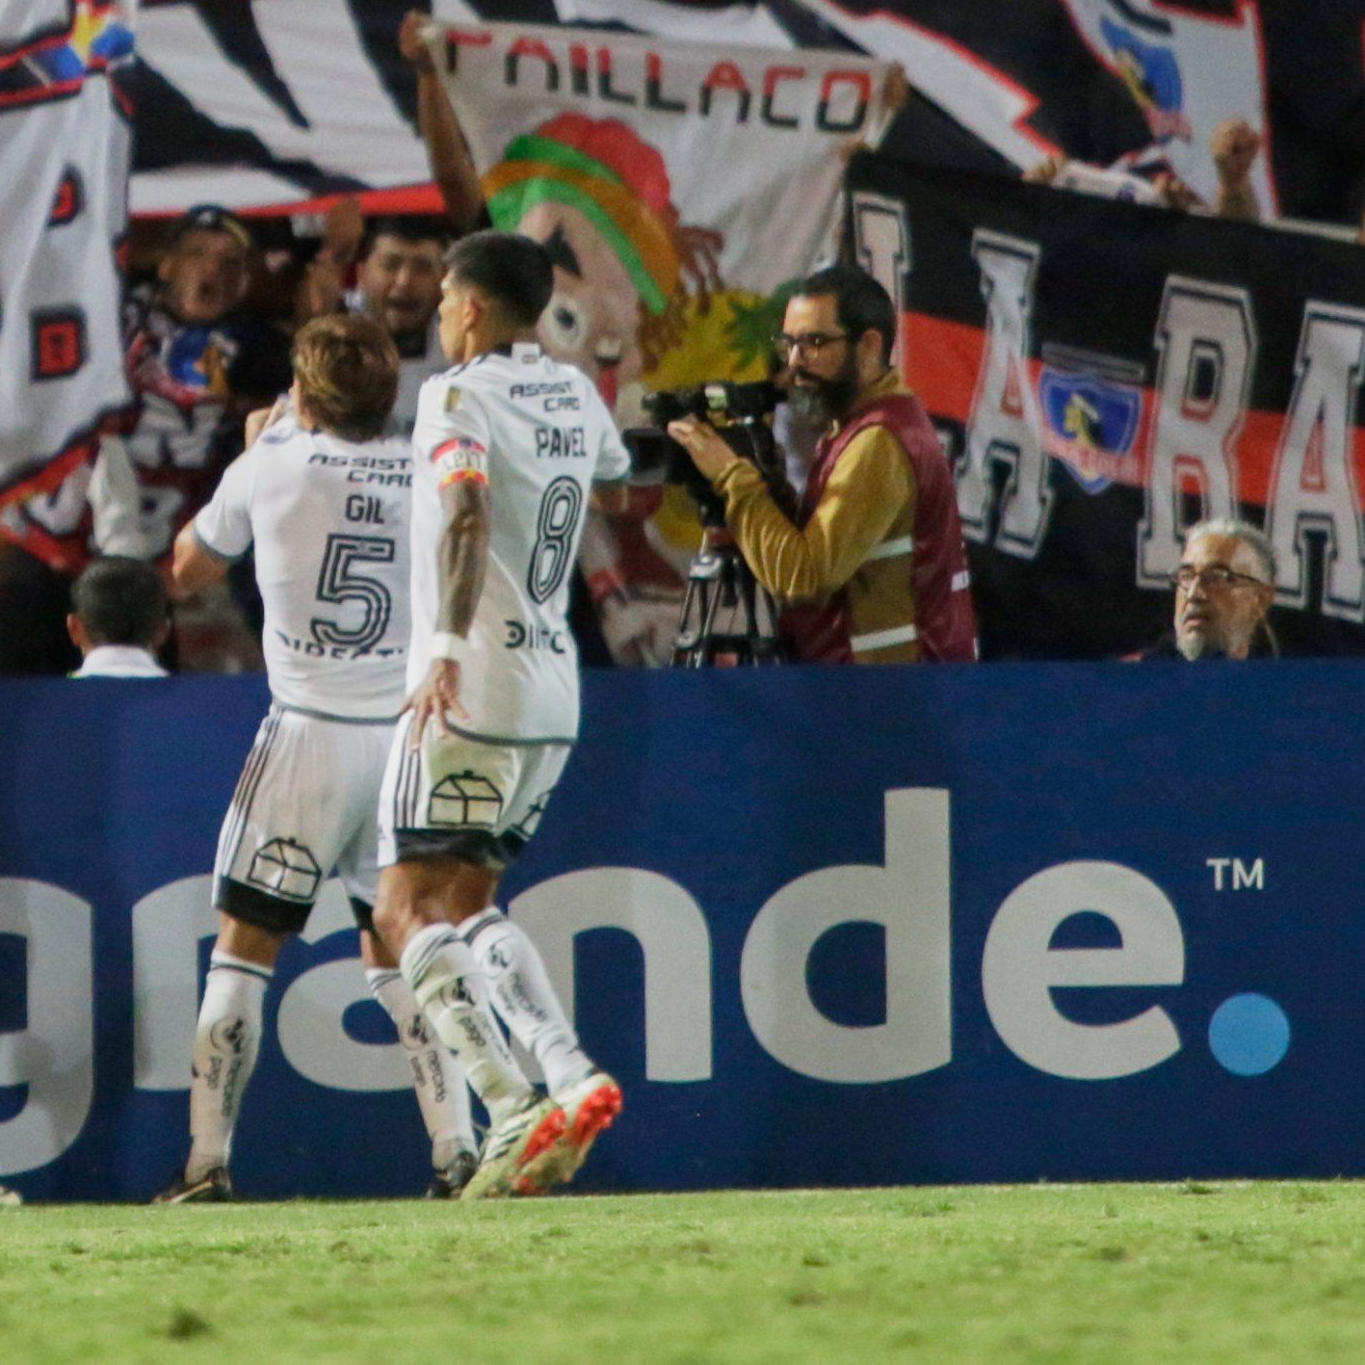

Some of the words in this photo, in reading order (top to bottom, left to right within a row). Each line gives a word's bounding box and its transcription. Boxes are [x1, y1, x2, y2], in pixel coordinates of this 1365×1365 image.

[307, 453, 412, 471] ASSIST
[345, 493, 385, 524] GIL
[527, 476, 582, 605] 8
[309, 533, 395, 655] 5
